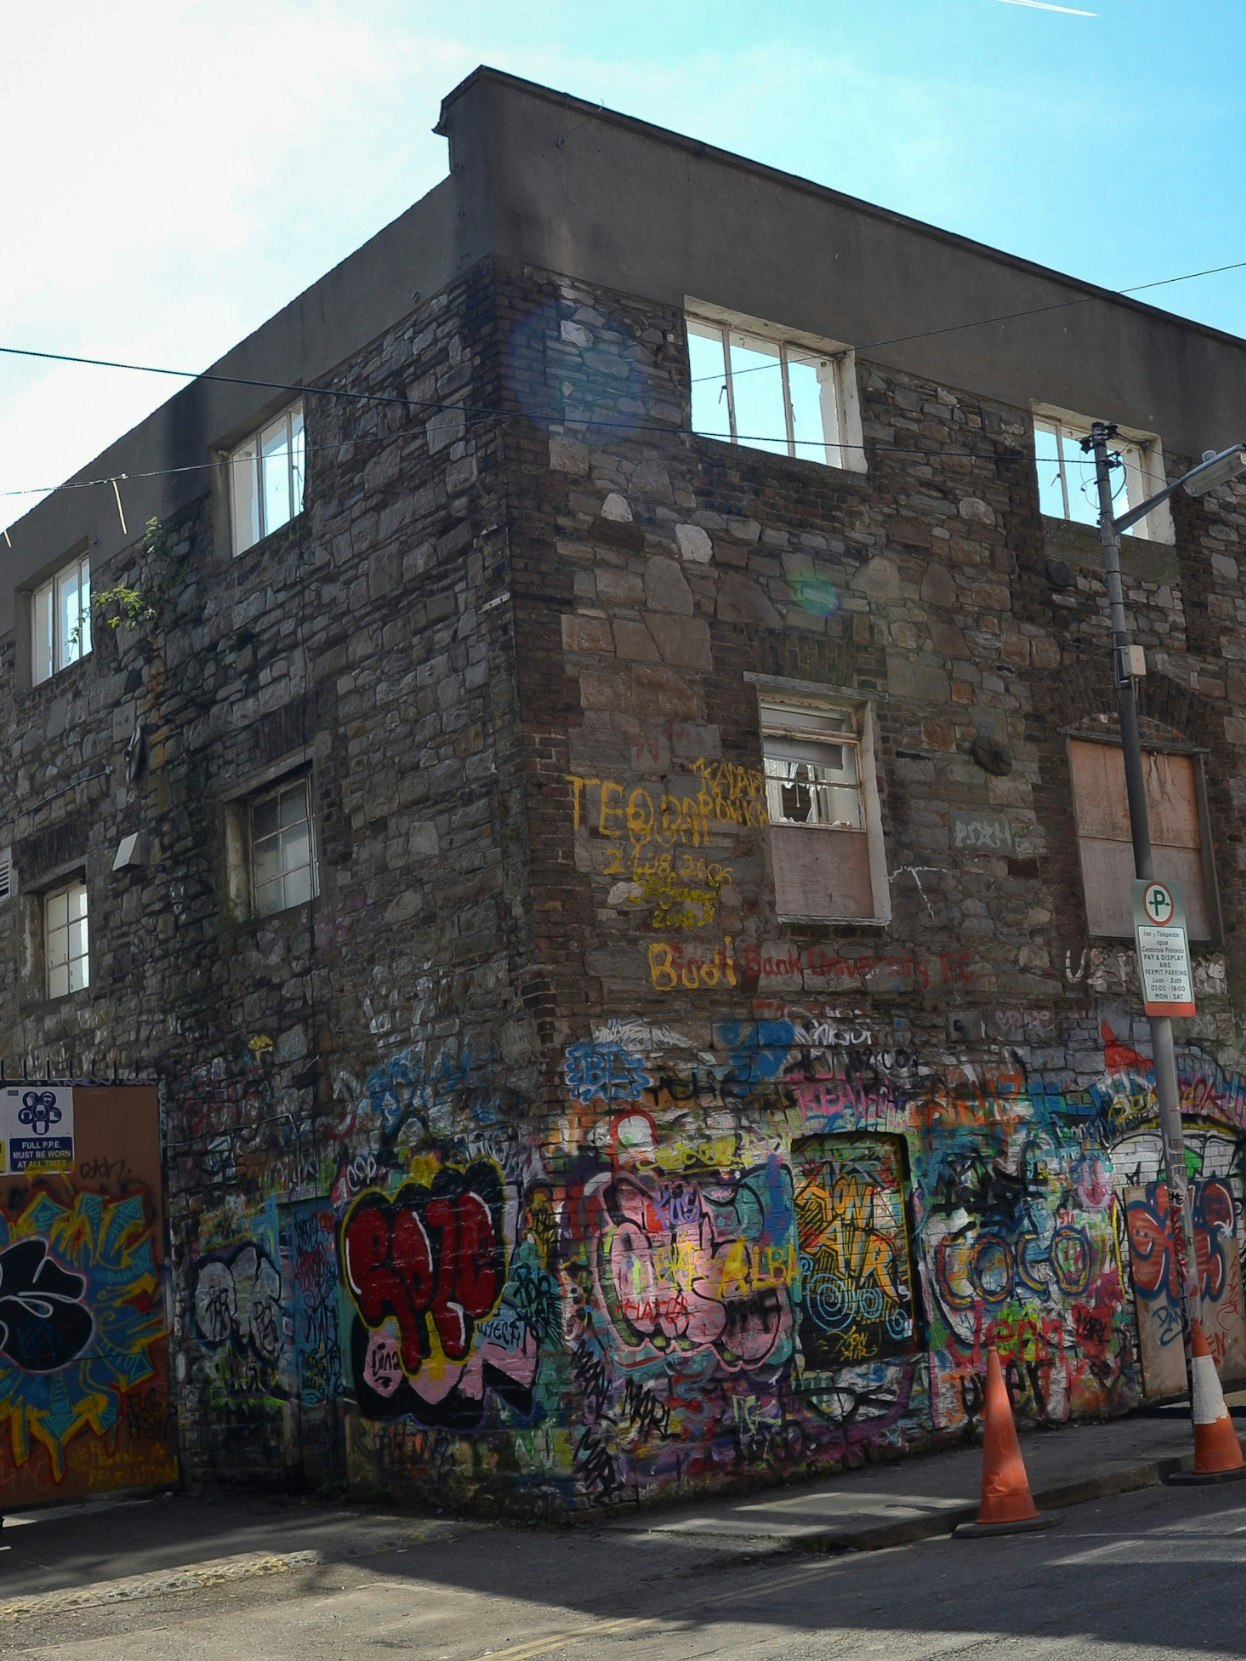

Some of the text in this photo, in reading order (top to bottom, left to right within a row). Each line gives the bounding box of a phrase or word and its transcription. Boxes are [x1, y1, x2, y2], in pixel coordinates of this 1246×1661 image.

[742, 943, 802, 977] Bank
[1144, 968, 1164, 976] PERMIT
[21, 1141, 41, 1149] FULL
[12, 1150, 71, 1159] MUST BE WORN
[17, 1160, 27, 1169] AT
[28, 1160, 43, 1168] ALL
